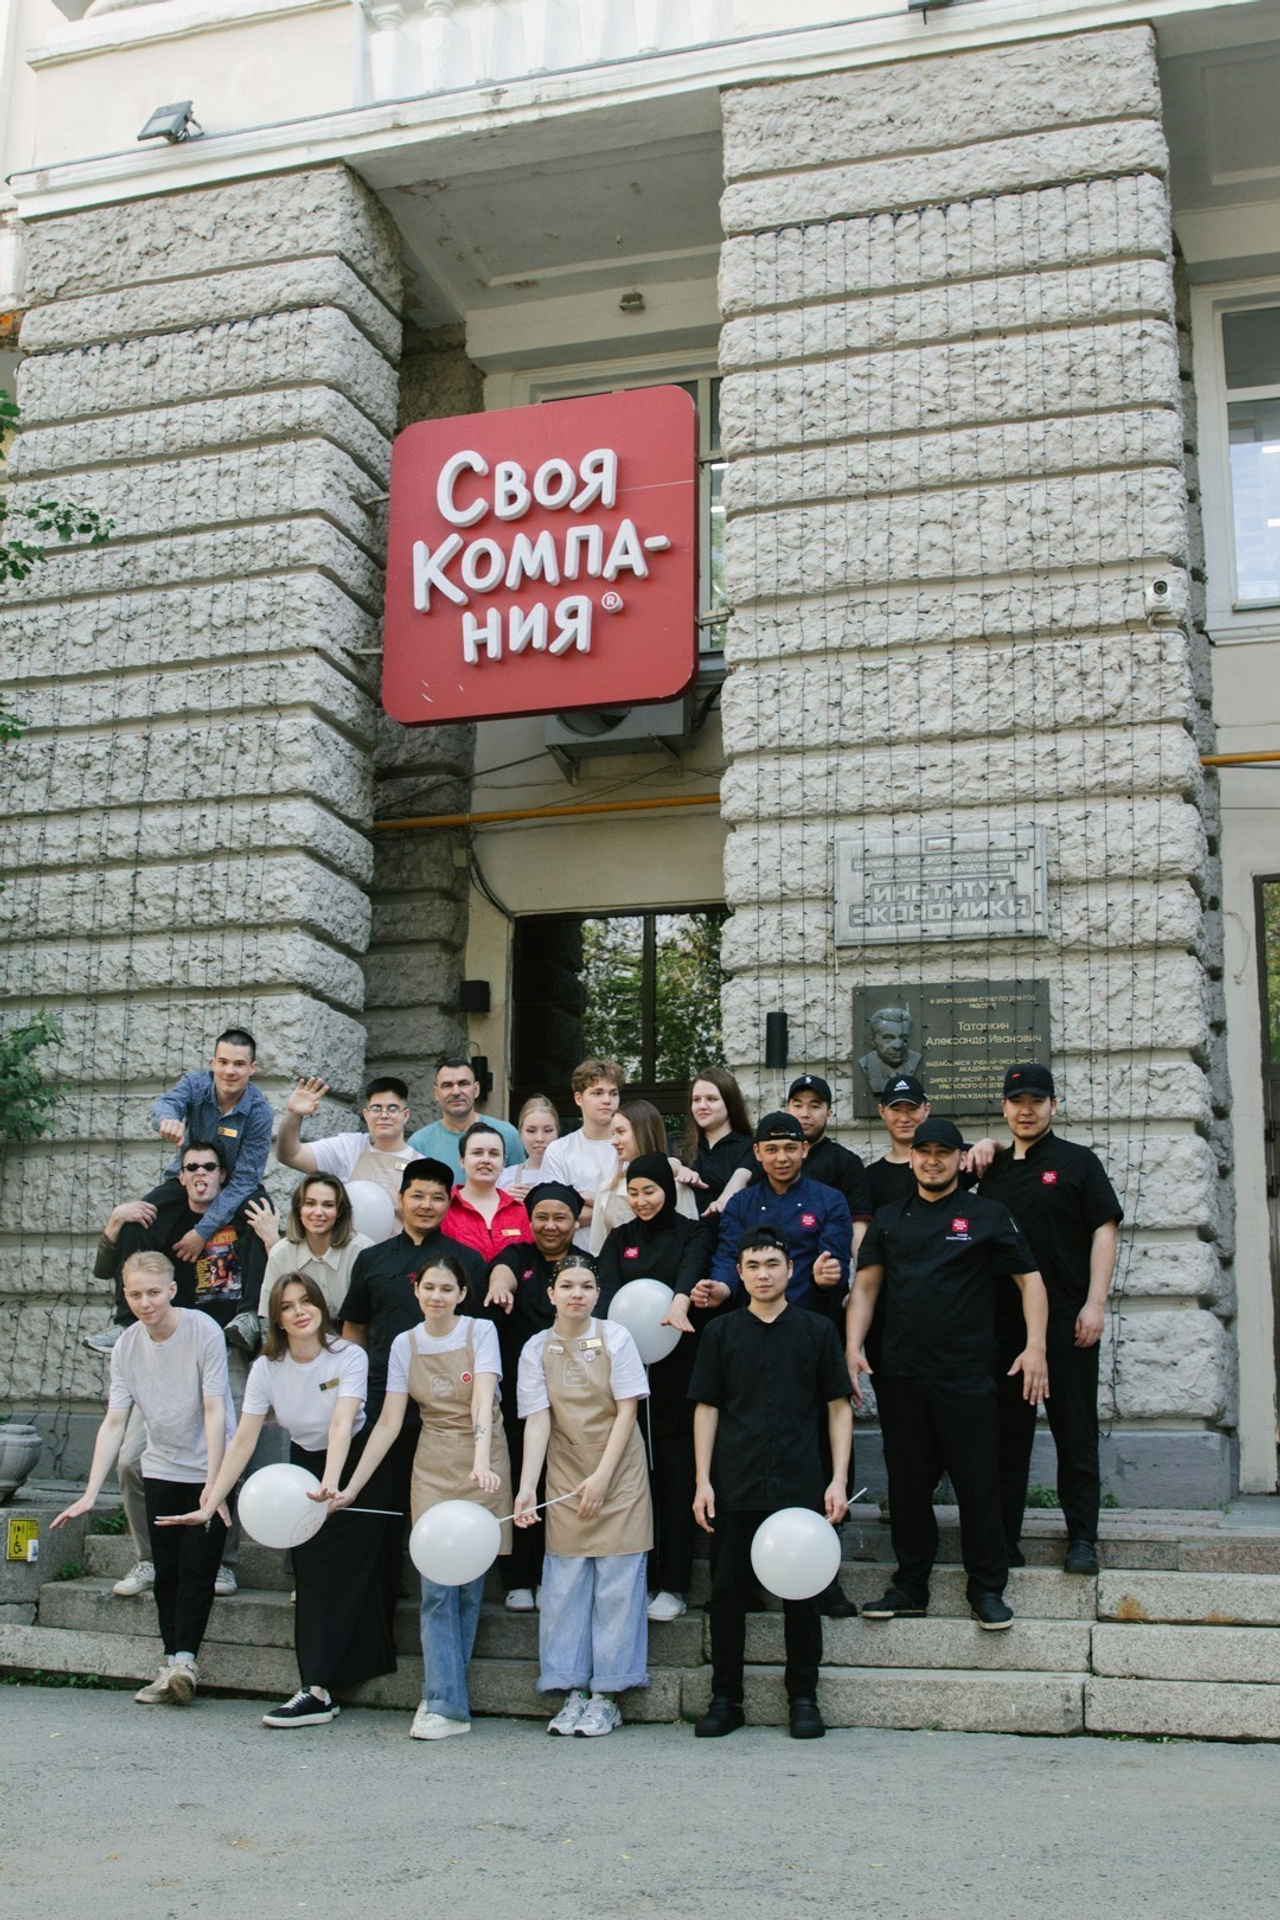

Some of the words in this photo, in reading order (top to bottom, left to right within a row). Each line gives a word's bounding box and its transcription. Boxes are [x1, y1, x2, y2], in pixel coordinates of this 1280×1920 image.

[873, 879, 1009, 904] ИНСТИТУТ
[852, 899, 1028, 926] ЭКОНОМИКИ
[958, 1021, 1009, 1031] Татаркин
[926, 1035, 986, 1046] Александр
[989, 1034, 1042, 1043] Иванович
